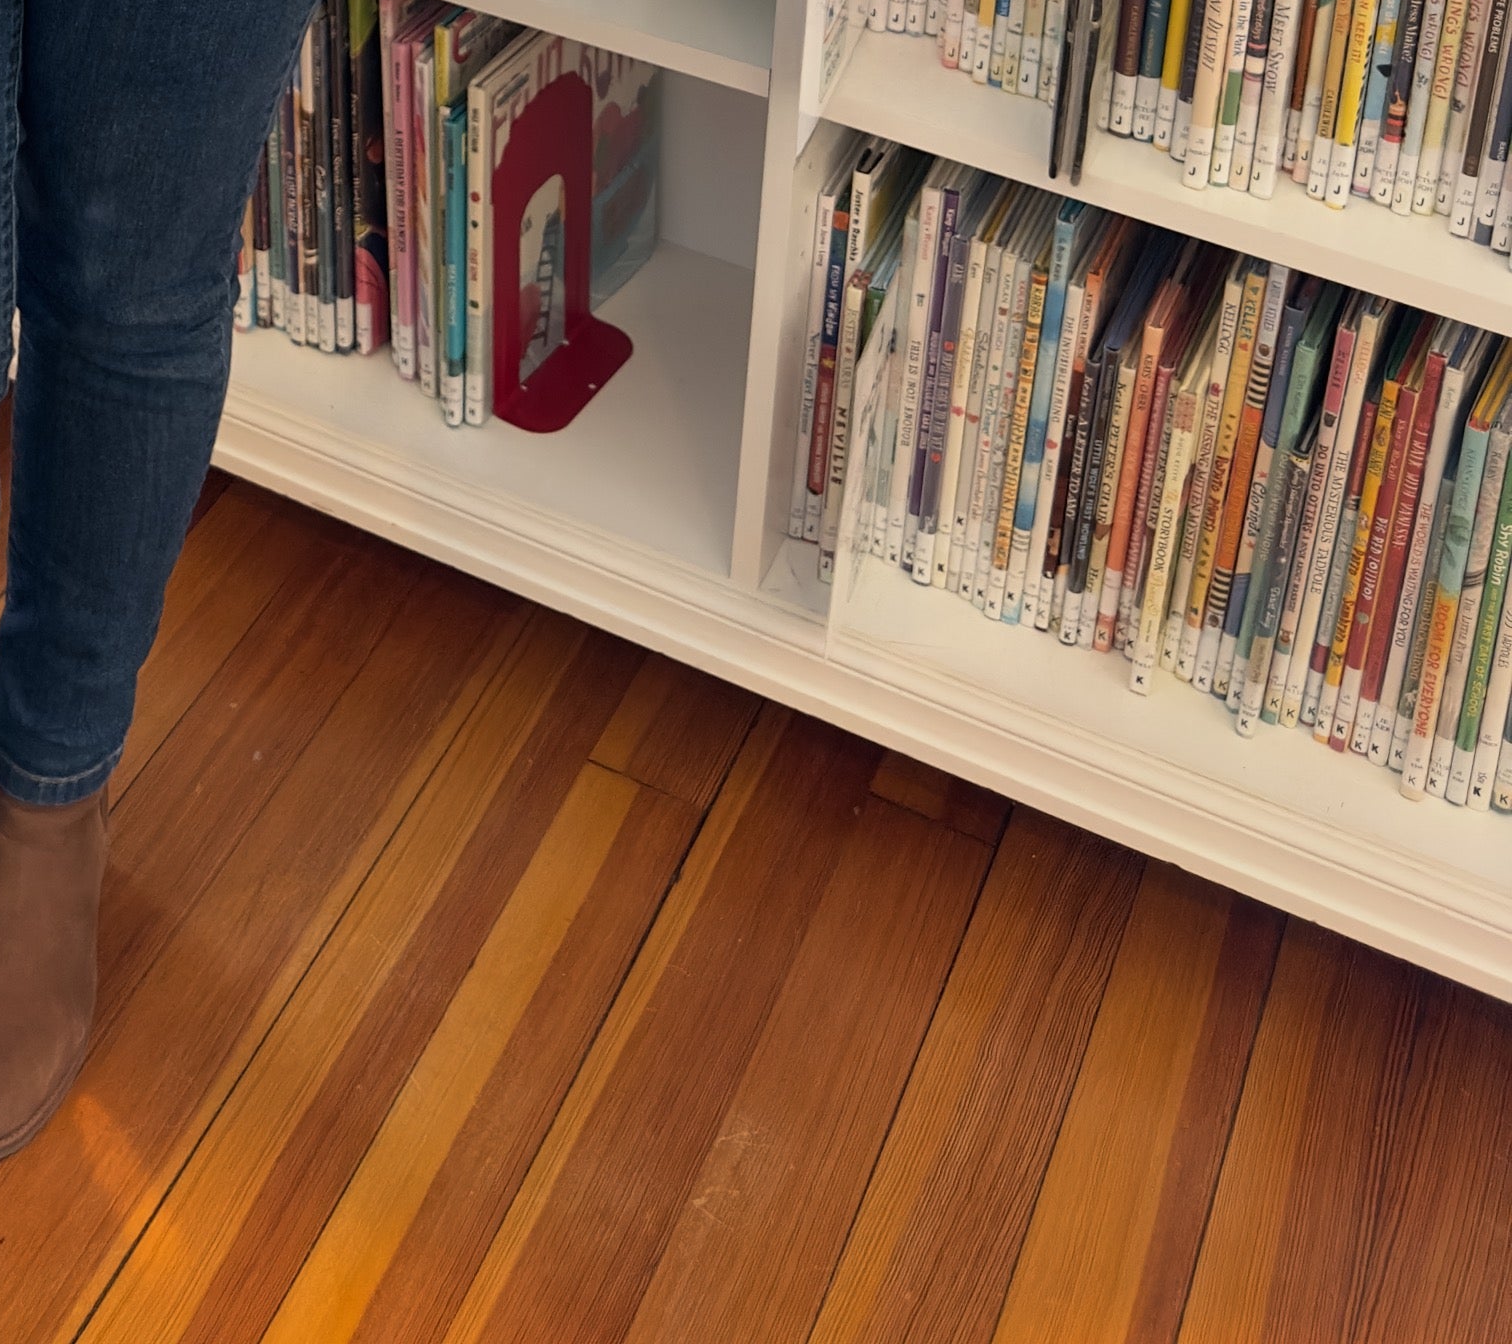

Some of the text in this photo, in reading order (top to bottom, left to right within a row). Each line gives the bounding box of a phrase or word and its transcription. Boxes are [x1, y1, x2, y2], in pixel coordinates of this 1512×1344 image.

[1201, 21, 1225, 74] DESSERT
[1488, 7, 1504, 54] PROBLEMS
[1432, 44, 1454, 100] WRONG!
[1219, 301, 1237, 356] KELLOGG
[1246, 481, 1268, 538] Clorinda
[1309, 450, 1349, 596] THE MYSTERIOUS TADPOLE
[1154, 508, 1174, 572] STORYBOOK
[1490, 523, 1512, 587] Shy Robin
[1414, 603, 1452, 739] ROOM FOR EVERYONE
